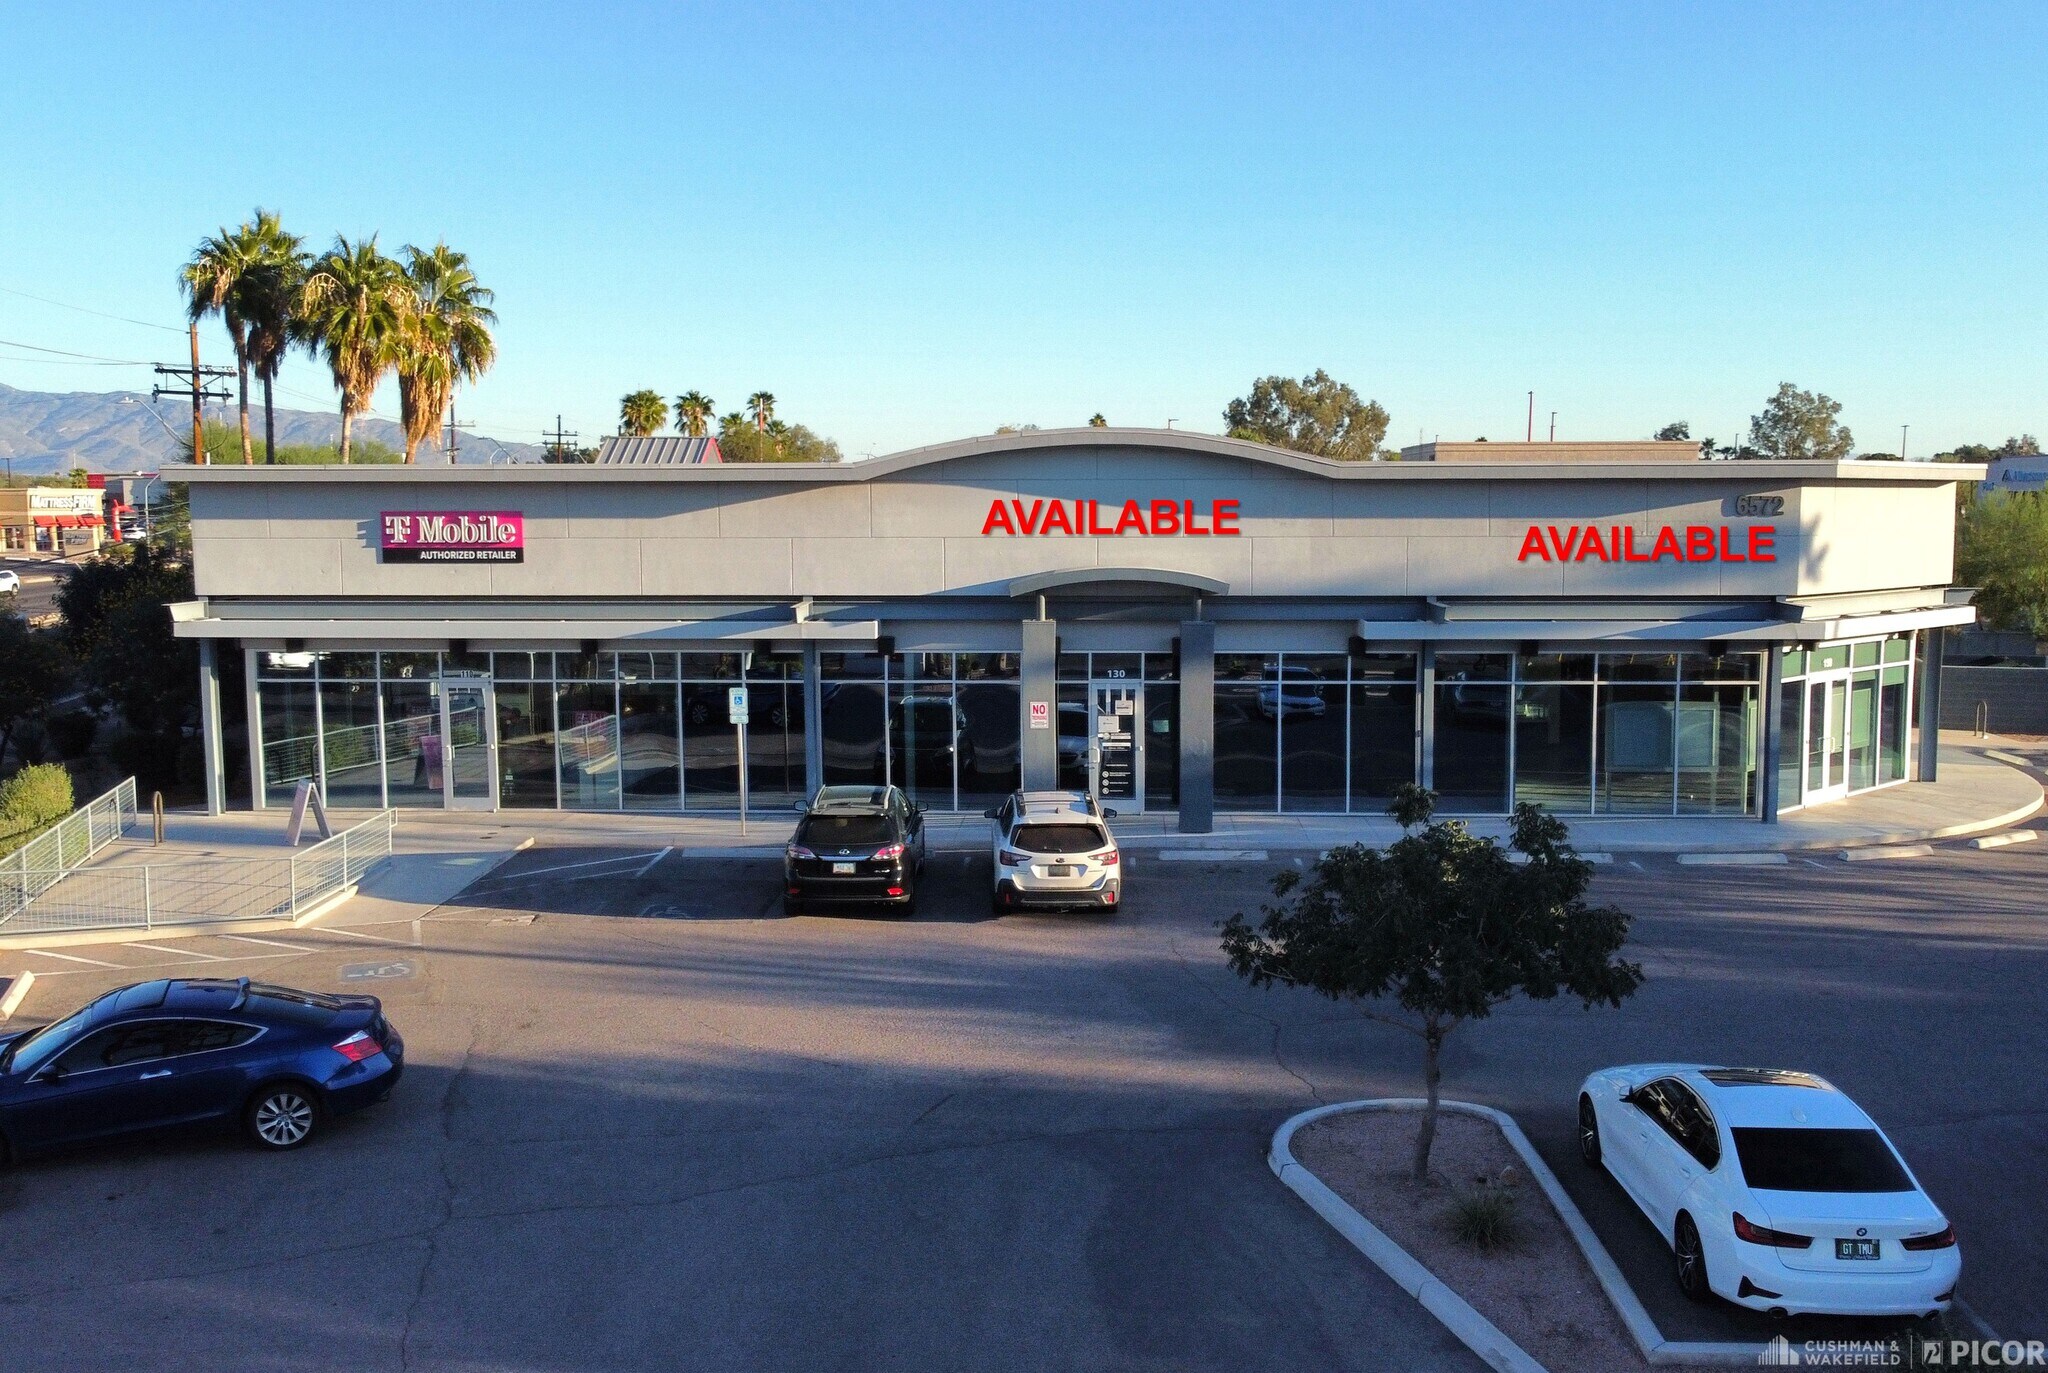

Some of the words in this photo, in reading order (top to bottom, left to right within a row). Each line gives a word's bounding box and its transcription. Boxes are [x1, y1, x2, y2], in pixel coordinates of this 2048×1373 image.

[1735, 495, 1784, 517] 6572
[416, 515, 516, 543] Mobile
[420, 551, 475, 560] AUTHORIZED
[476, 551, 517, 560] RETAILER
[1107, 669, 1126, 678] 130
[1032, 704, 1046, 715] NO
[1842, 1243, 1853, 1255] GT
